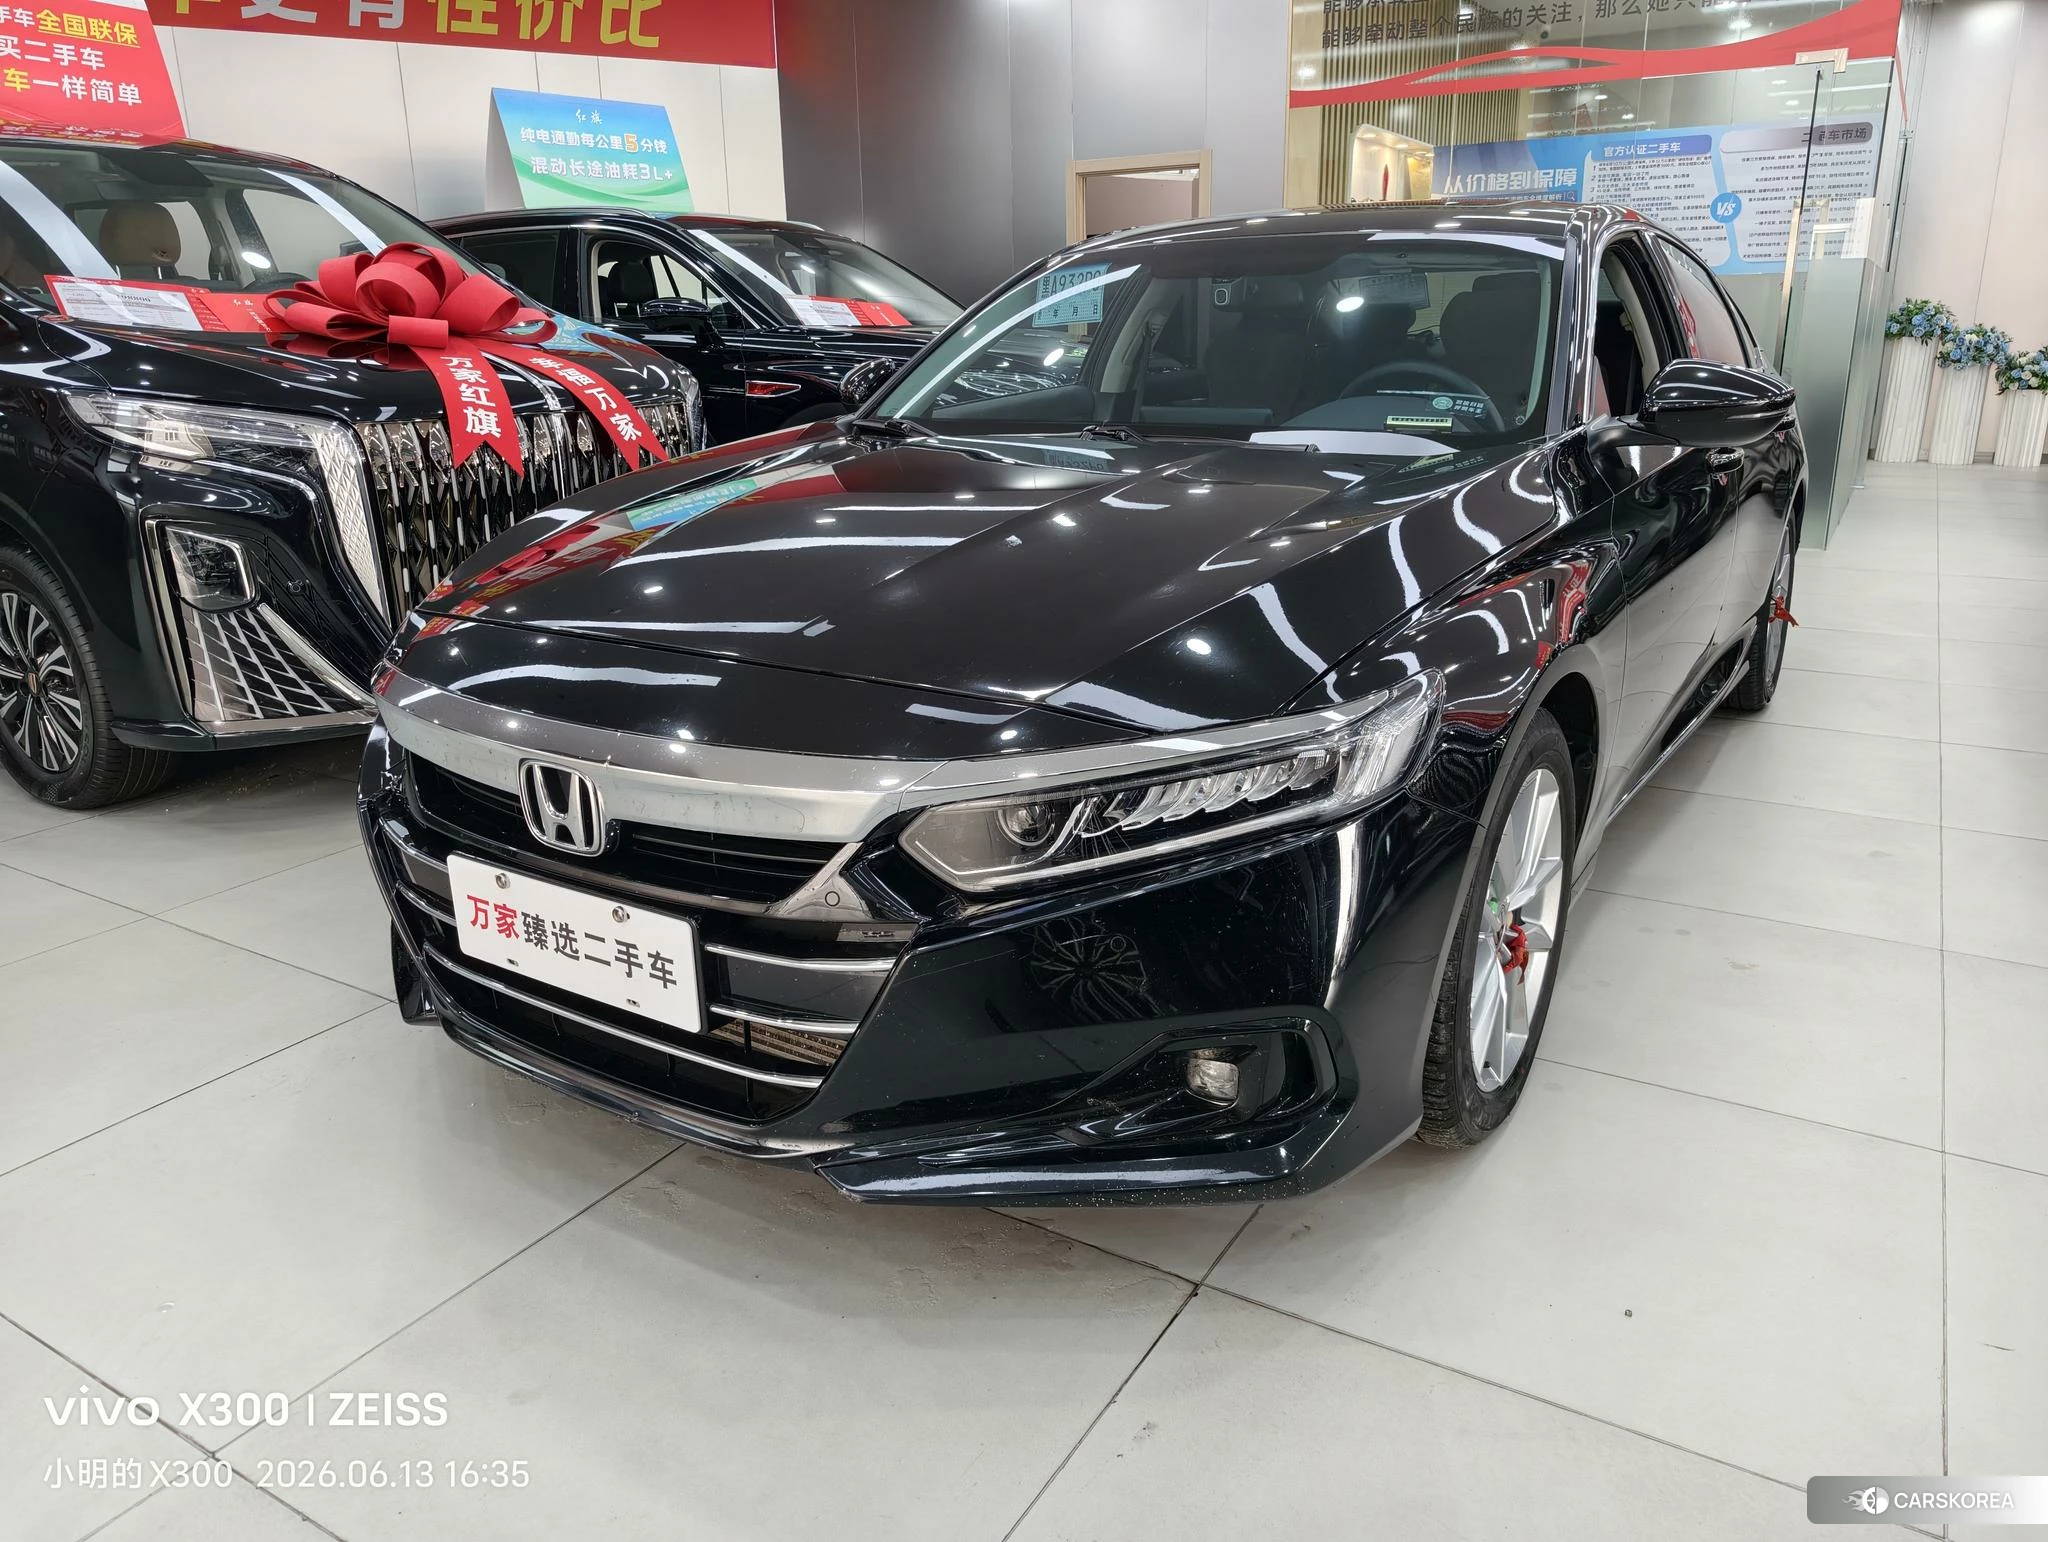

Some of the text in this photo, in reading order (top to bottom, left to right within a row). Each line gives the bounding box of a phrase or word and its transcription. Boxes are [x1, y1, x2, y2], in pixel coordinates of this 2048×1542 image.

[0, 35, 106, 71] 买二手车
[3, 67, 143, 106] 车一样简单
[519, 126, 668, 155] 纯电通勤每公里5分钱
[1603, 142, 1681, 157] 官方认证二手车
[530, 156, 674, 182] 混动长途油耗3L+
[1443, 168, 1577, 194] 从价格到保障
[1716, 201, 1737, 216] VS
[440, 355, 502, 439] 万家红旗
[466, 894, 678, 990] 万家臻选二手车
